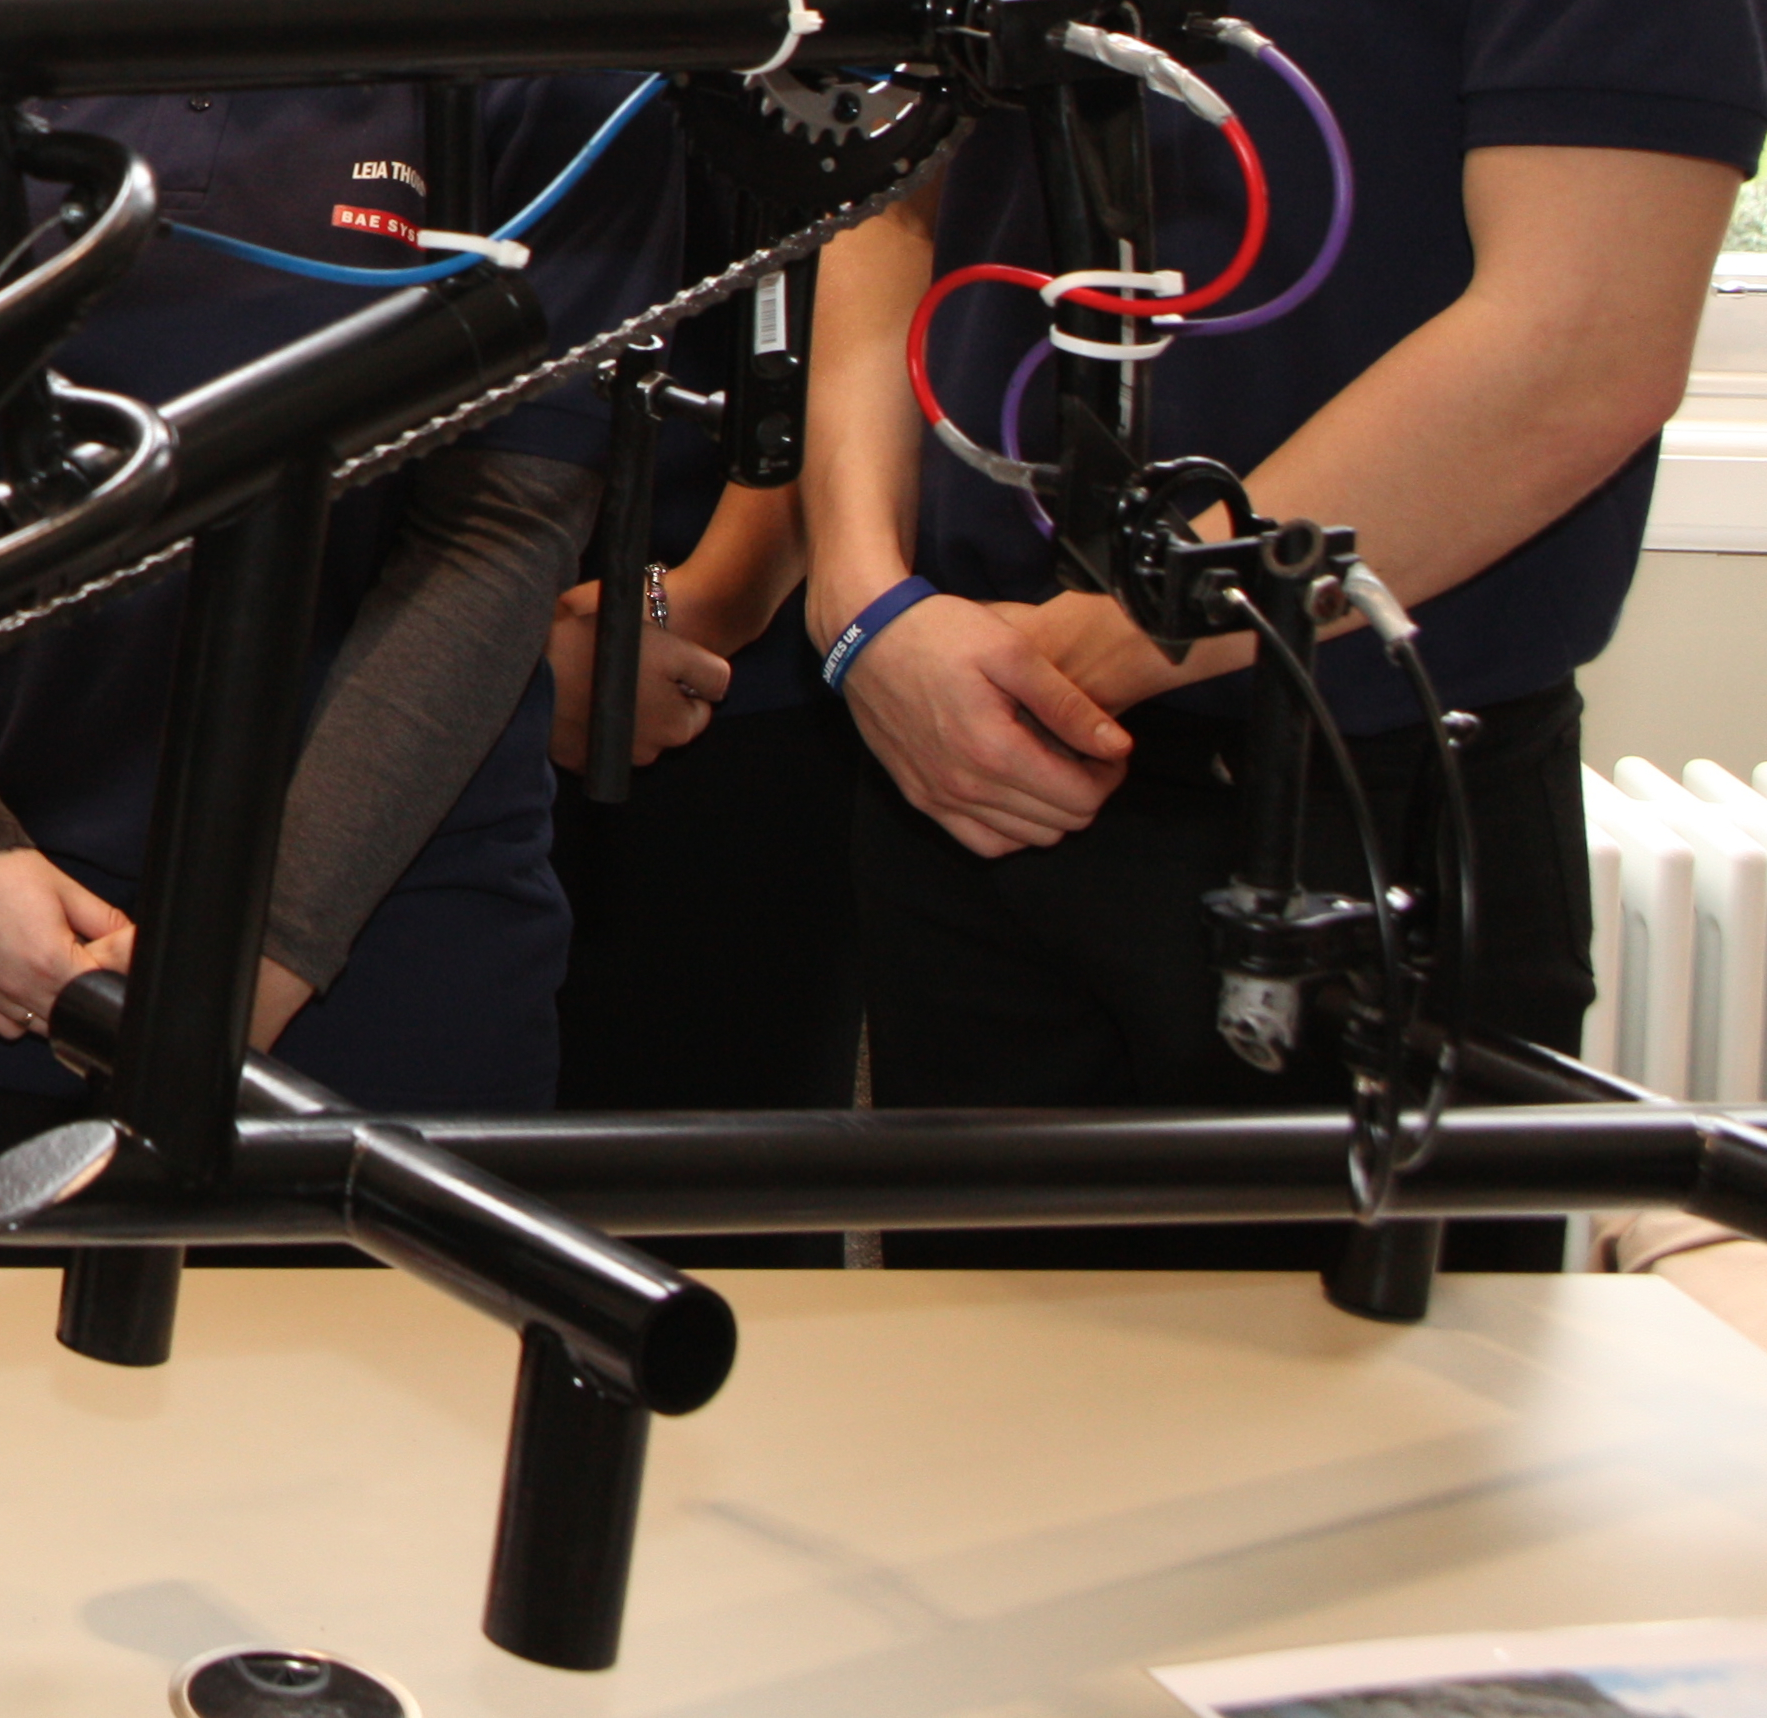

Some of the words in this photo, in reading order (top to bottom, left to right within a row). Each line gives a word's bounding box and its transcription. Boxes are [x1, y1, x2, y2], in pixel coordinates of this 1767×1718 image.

[351, 160, 388, 180] LEIA
[341, 210, 381, 229] BAE
[387, 218, 416, 243] SYS
[842, 623, 863, 644] UK
